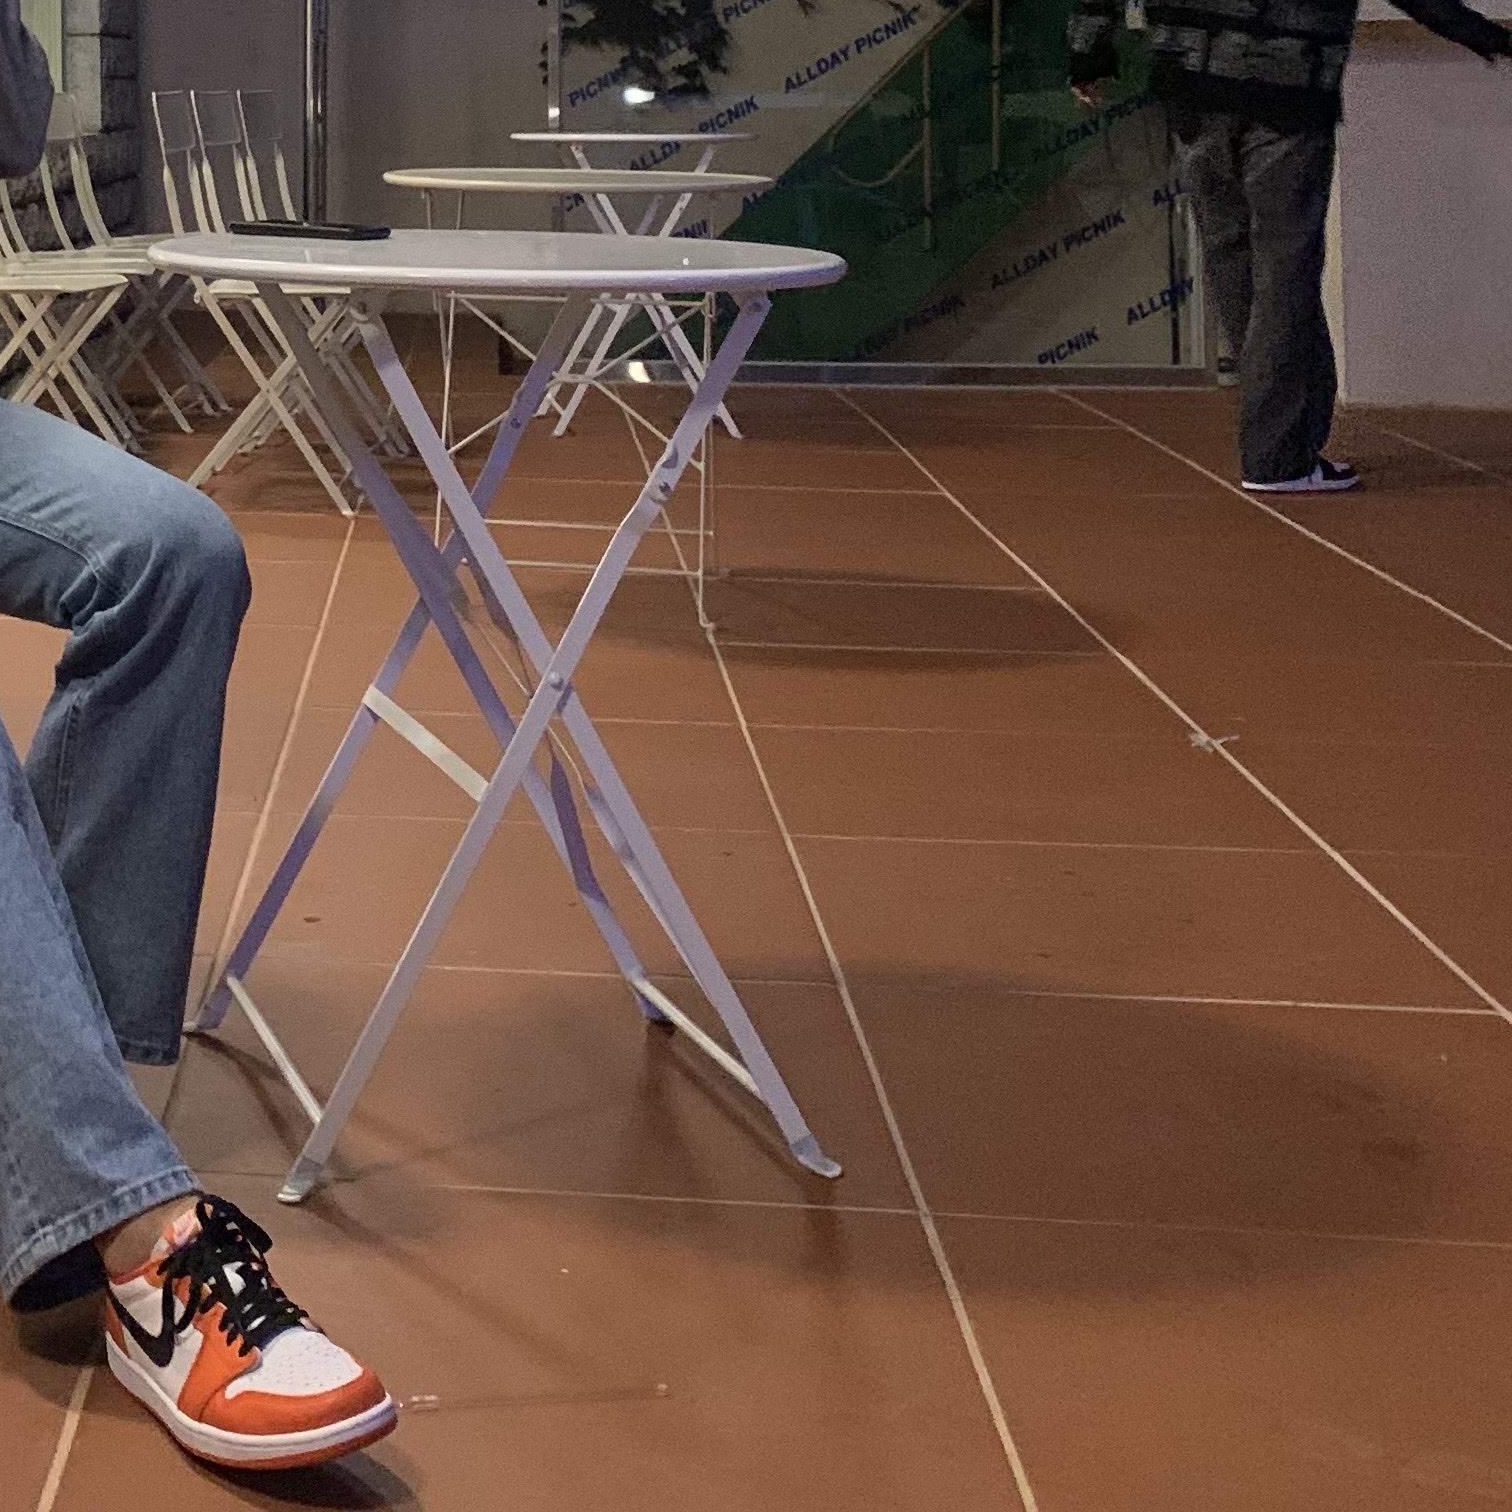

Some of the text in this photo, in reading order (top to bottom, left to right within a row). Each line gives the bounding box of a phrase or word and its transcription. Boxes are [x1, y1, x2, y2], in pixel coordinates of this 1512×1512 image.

[784, 44, 851, 94] ALLDAY
[854, 9, 918, 55] PICNIK
[698, 95, 759, 134] PICNIK
[991, 209, 1126, 289] ALLDAY PICNIK
[1037, 326, 1099, 366] PICNIK
